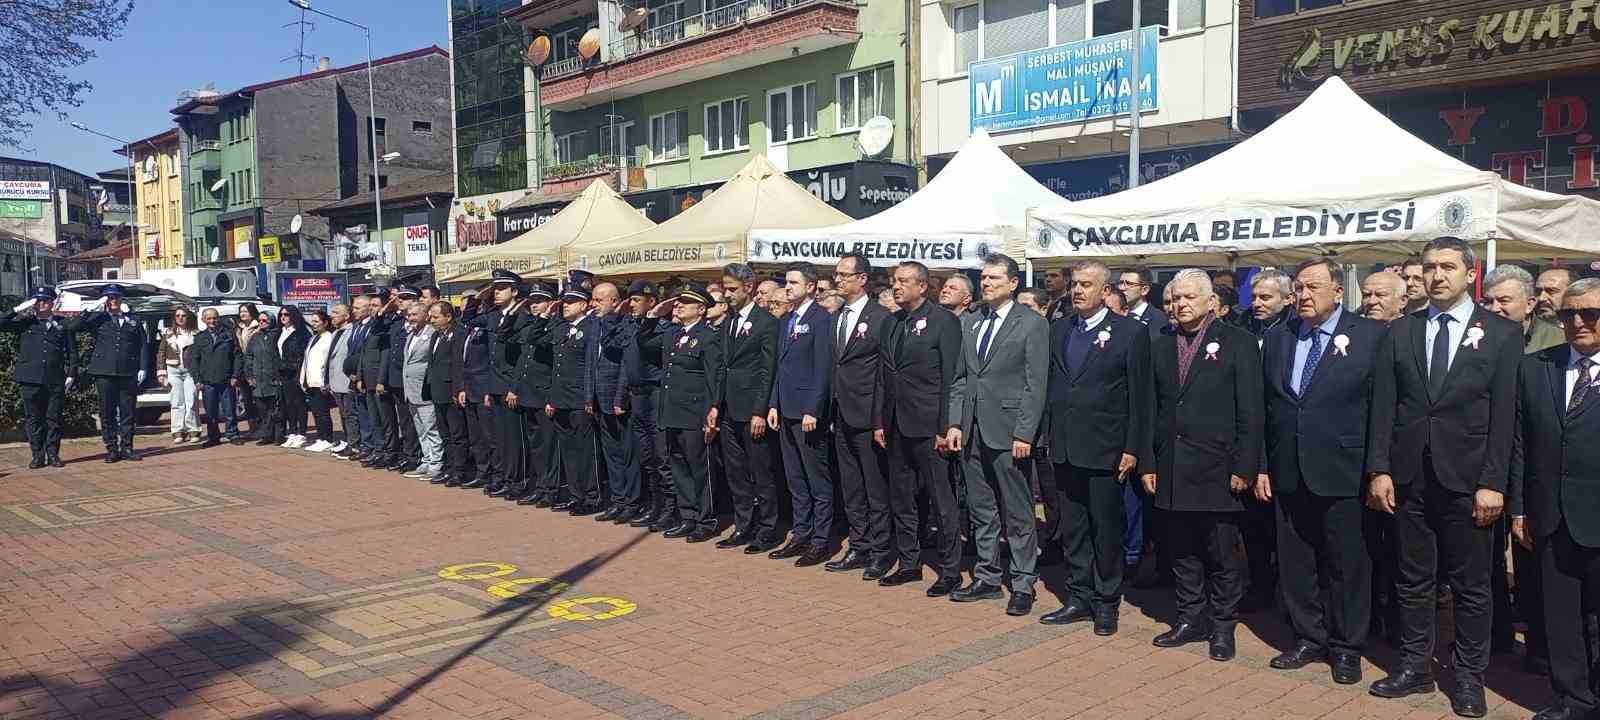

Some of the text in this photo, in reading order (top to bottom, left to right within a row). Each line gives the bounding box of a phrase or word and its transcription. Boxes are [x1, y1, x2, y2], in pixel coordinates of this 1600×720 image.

[1027, 50, 1073, 69] SERBEST
[1046, 56, 1124, 81] MALİ MÜŞAVİR
[1024, 80, 1091, 112] İSMAİL
[406, 226, 429, 241] ONUR
[1066, 220, 1200, 251] ÇAYCUMA
[1210, 201, 1417, 242] BELEDİYESİ
[598, 244, 702, 269] ÇAYCUMA BELEDİYESİ
[771, 238, 964, 261] ÇAYCUMA BELEDİYESİ
